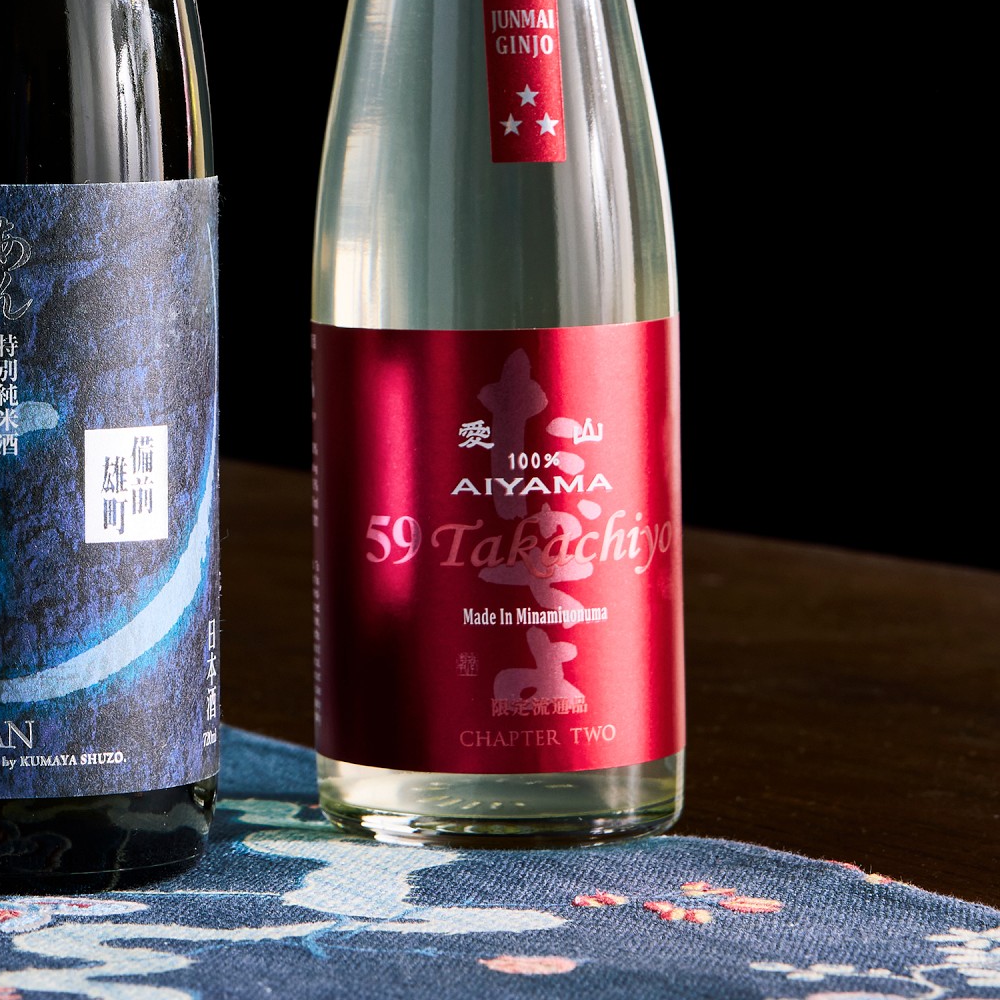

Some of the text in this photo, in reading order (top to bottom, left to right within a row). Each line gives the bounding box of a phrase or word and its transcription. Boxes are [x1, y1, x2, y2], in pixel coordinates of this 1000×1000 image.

[491, 9, 555, 33] JUNMAI
[496, 35, 553, 58] GINJO
[508, 451, 560, 470] 100%
[131, 435, 154, 515] 備前
[451, 474, 613, 496] AIYAMA
[101, 455, 128, 535] 雄町
[366, 509, 672, 578] 59 Takachiyo
[463, 604, 609, 626] Made In Minamiuonuma
[206, 618, 217, 721] 日本酒
[491, 696, 588, 717] 限定流通品
[459, 723, 616, 748] CHAPTER TWO
[2, 756, 16, 770] by
[19, 754, 77, 767] KUMAYA
